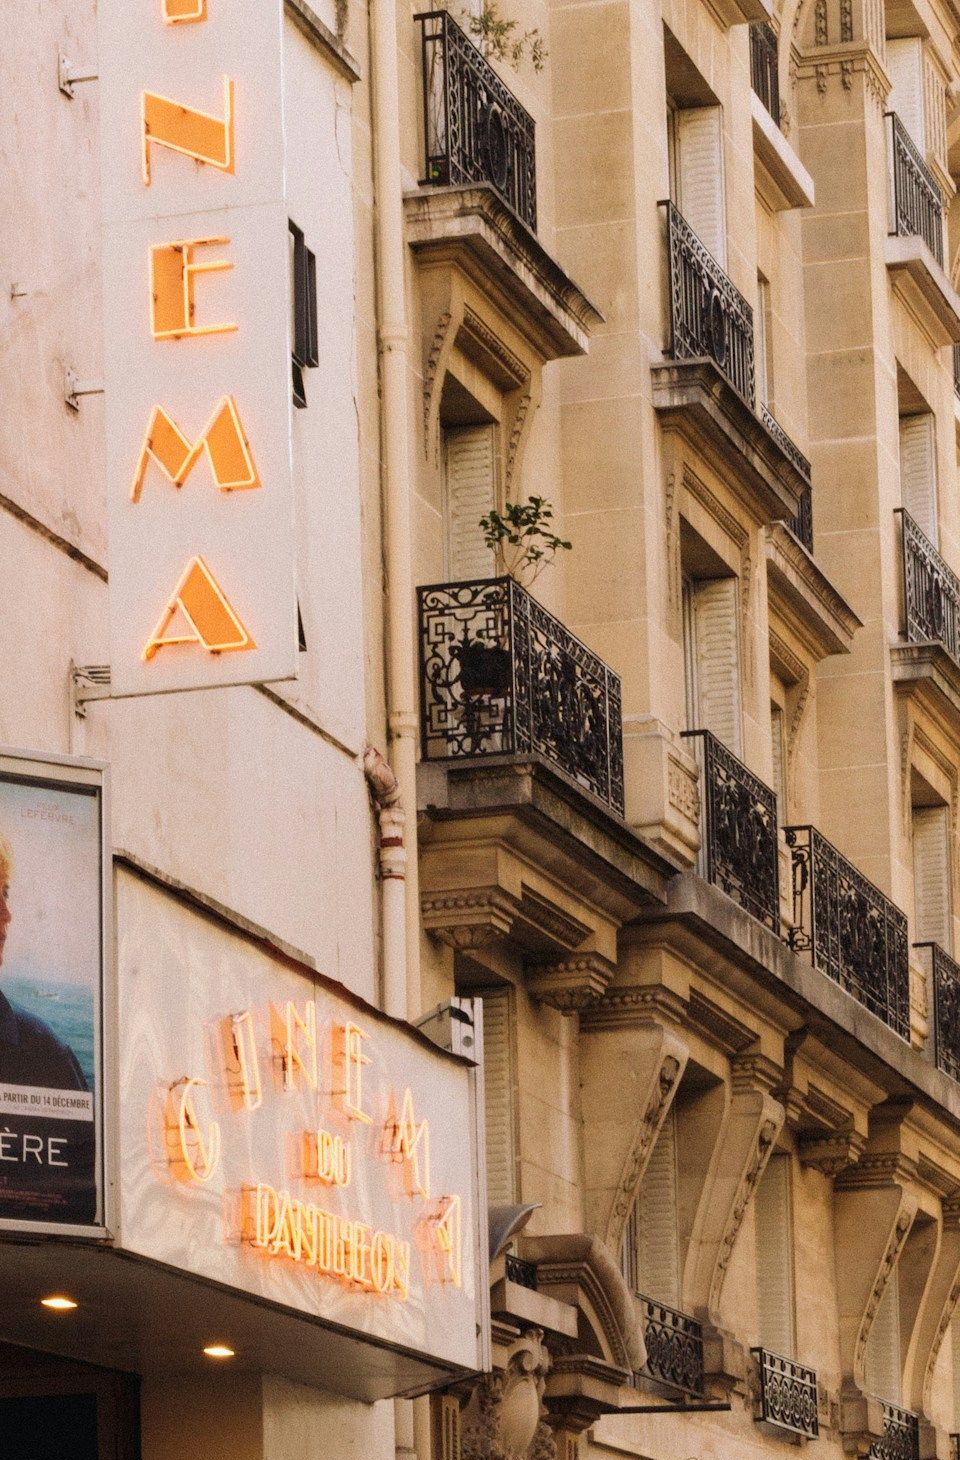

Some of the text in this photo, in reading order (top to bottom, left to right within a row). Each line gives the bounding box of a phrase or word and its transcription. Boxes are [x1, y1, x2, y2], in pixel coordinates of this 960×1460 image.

[132, 0, 263, 661] NEMA
[3, 1092, 28, 1103] PARTIR
[30, 1095, 41, 1105] DU
[43, 1096, 51, 1106] 14
[52, 1096, 90, 1110] DÉCEMBRE
